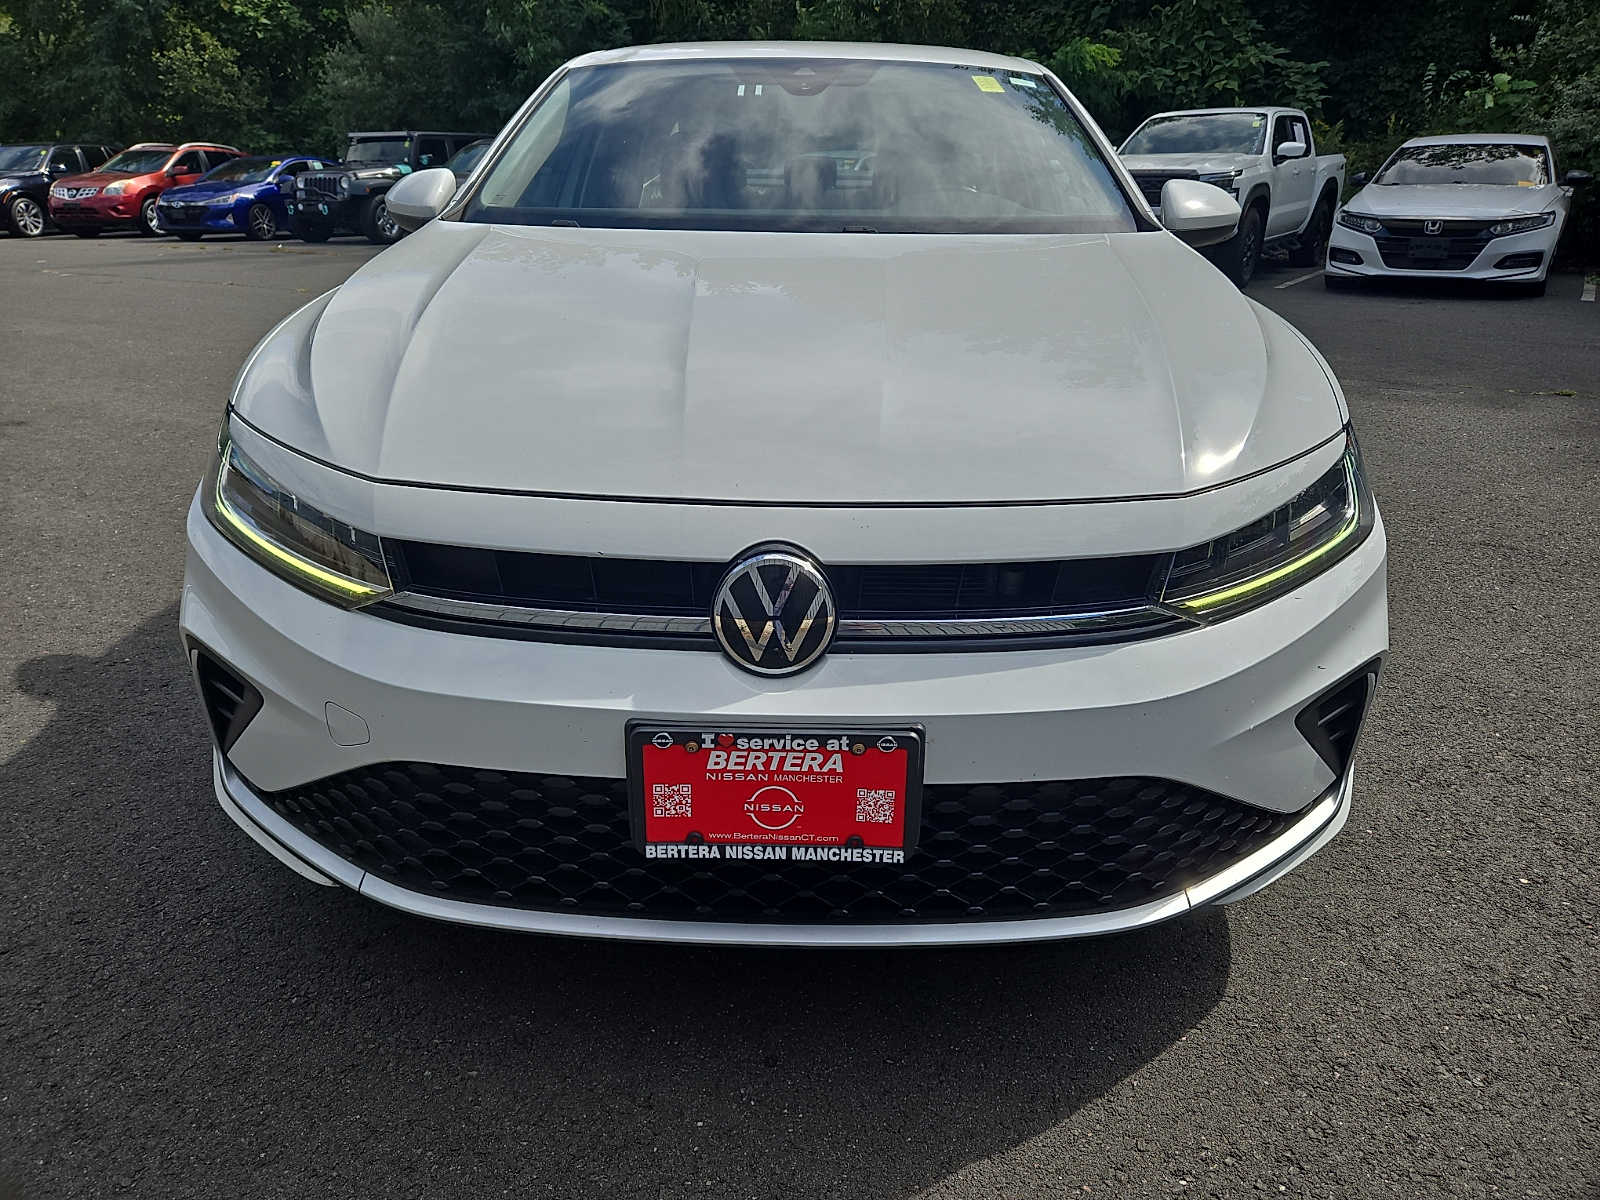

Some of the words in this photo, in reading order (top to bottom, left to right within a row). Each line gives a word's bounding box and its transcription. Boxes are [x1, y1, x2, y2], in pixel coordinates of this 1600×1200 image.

[701, 733, 716, 749] I
[736, 735, 819, 751] service
[826, 736, 849, 751] at
[706, 750, 844, 773] BERTERA
[706, 772, 769, 782] NISSAN
[774, 774, 843, 784] MANCHESTER
[744, 803, 804, 813] NISSAN
[708, 832, 839, 843] www.BerteraNissanCT.com
[645, 845, 720, 859] BERTERA
[726, 846, 787, 860] NISSAN
[791, 847, 905, 863] MANCHESTER
